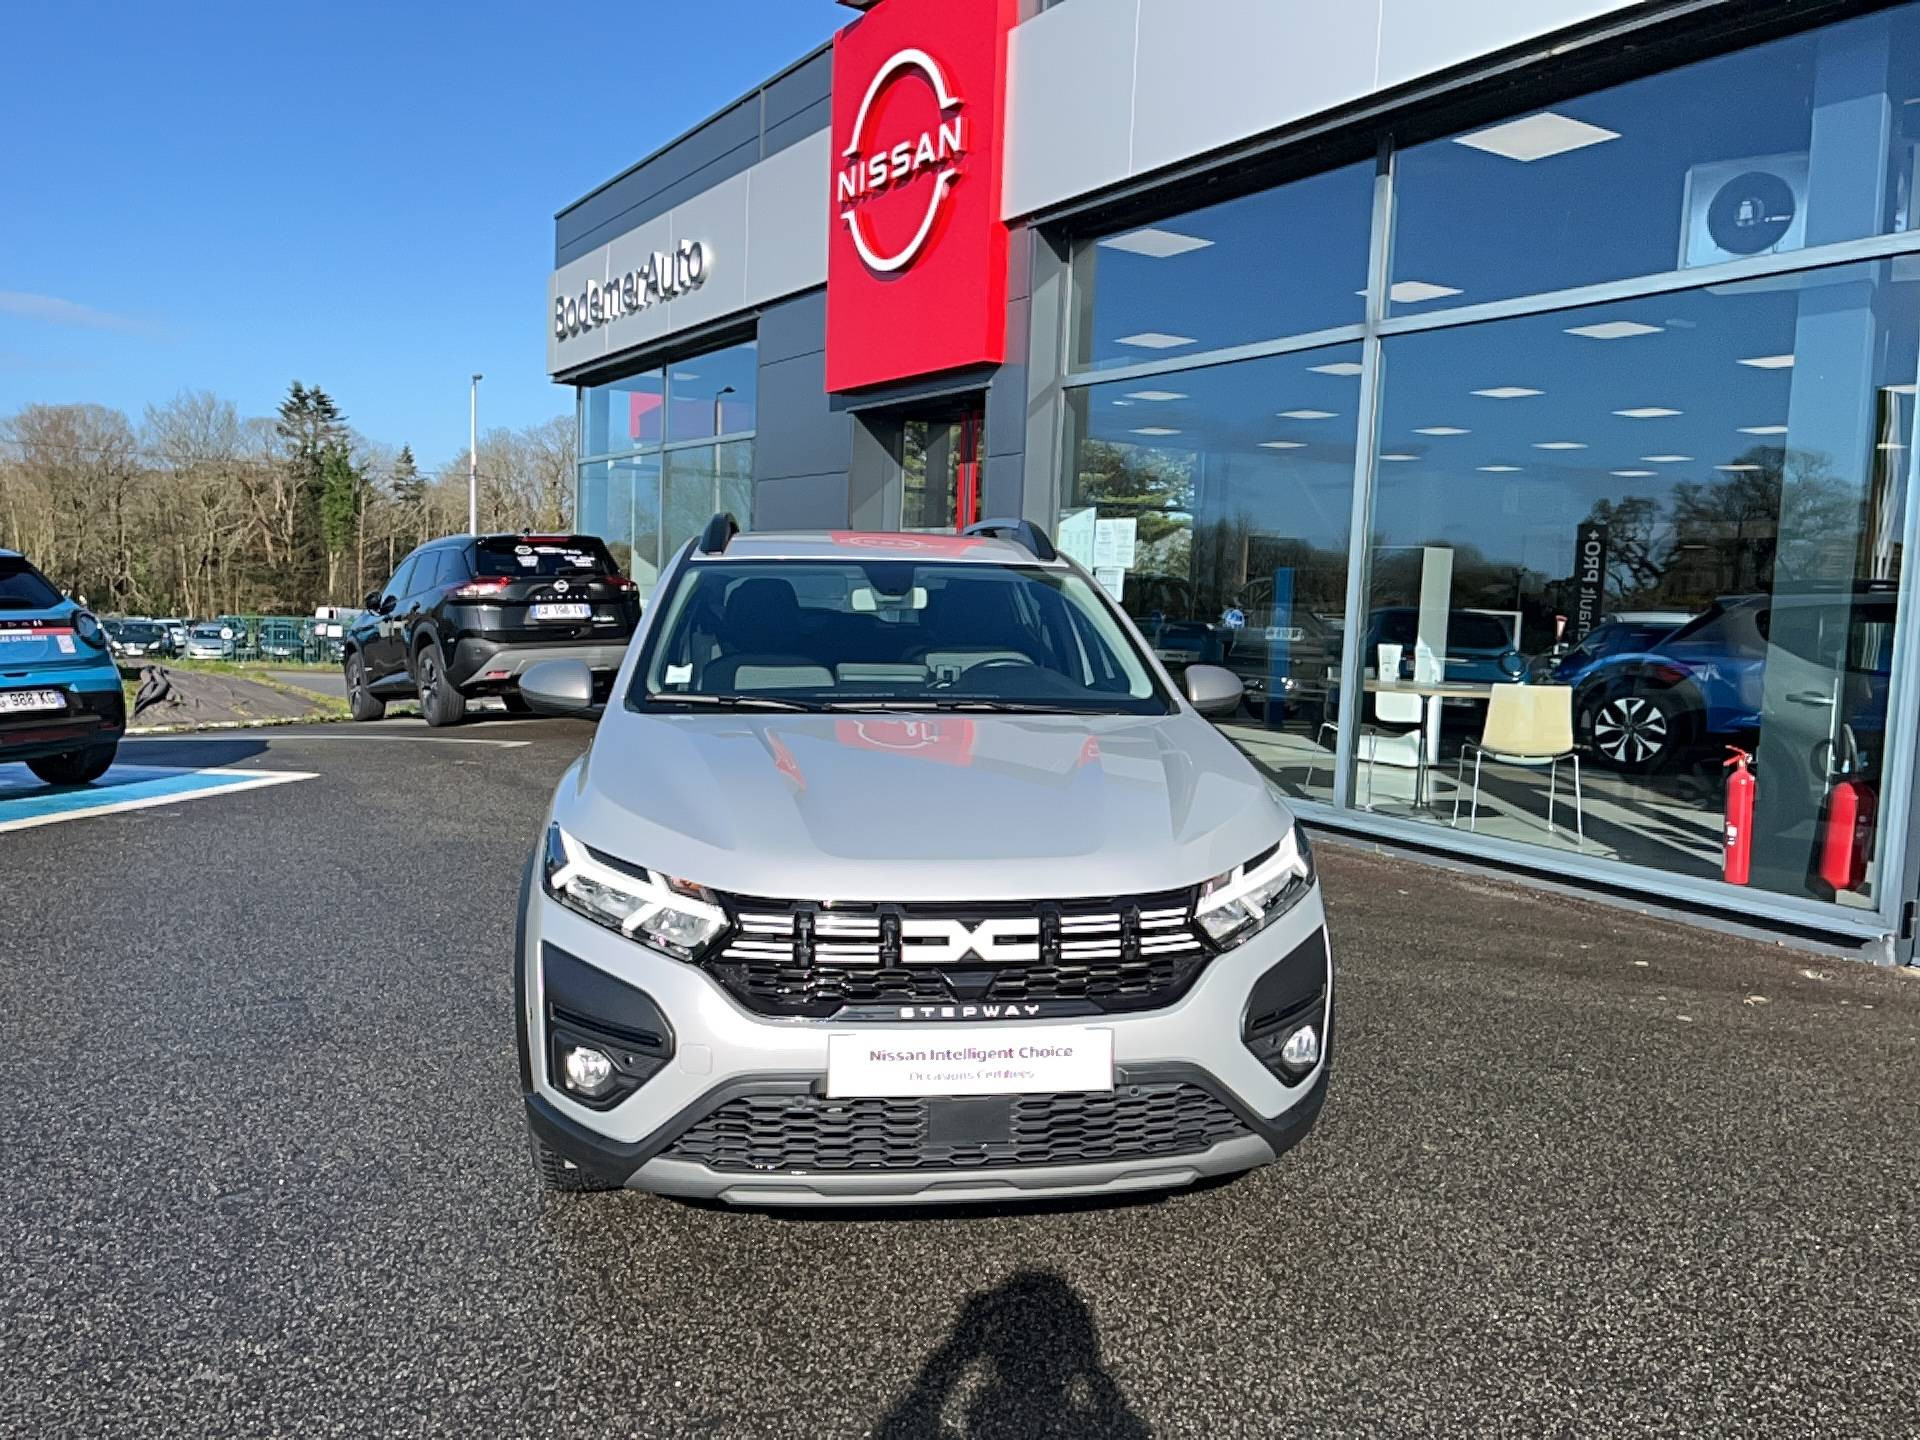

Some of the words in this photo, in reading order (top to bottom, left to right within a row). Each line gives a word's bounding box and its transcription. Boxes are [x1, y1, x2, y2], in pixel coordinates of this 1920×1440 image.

[837, 115, 962, 203] NISSAN
[555, 239, 706, 341] BodemerAuto
[900, 1005, 1041, 1019] STEPWAY
[870, 1050, 927, 1062] Nissan
[930, 1048, 1014, 1062] Intelligent
[1018, 1045, 1073, 1059] Choice
